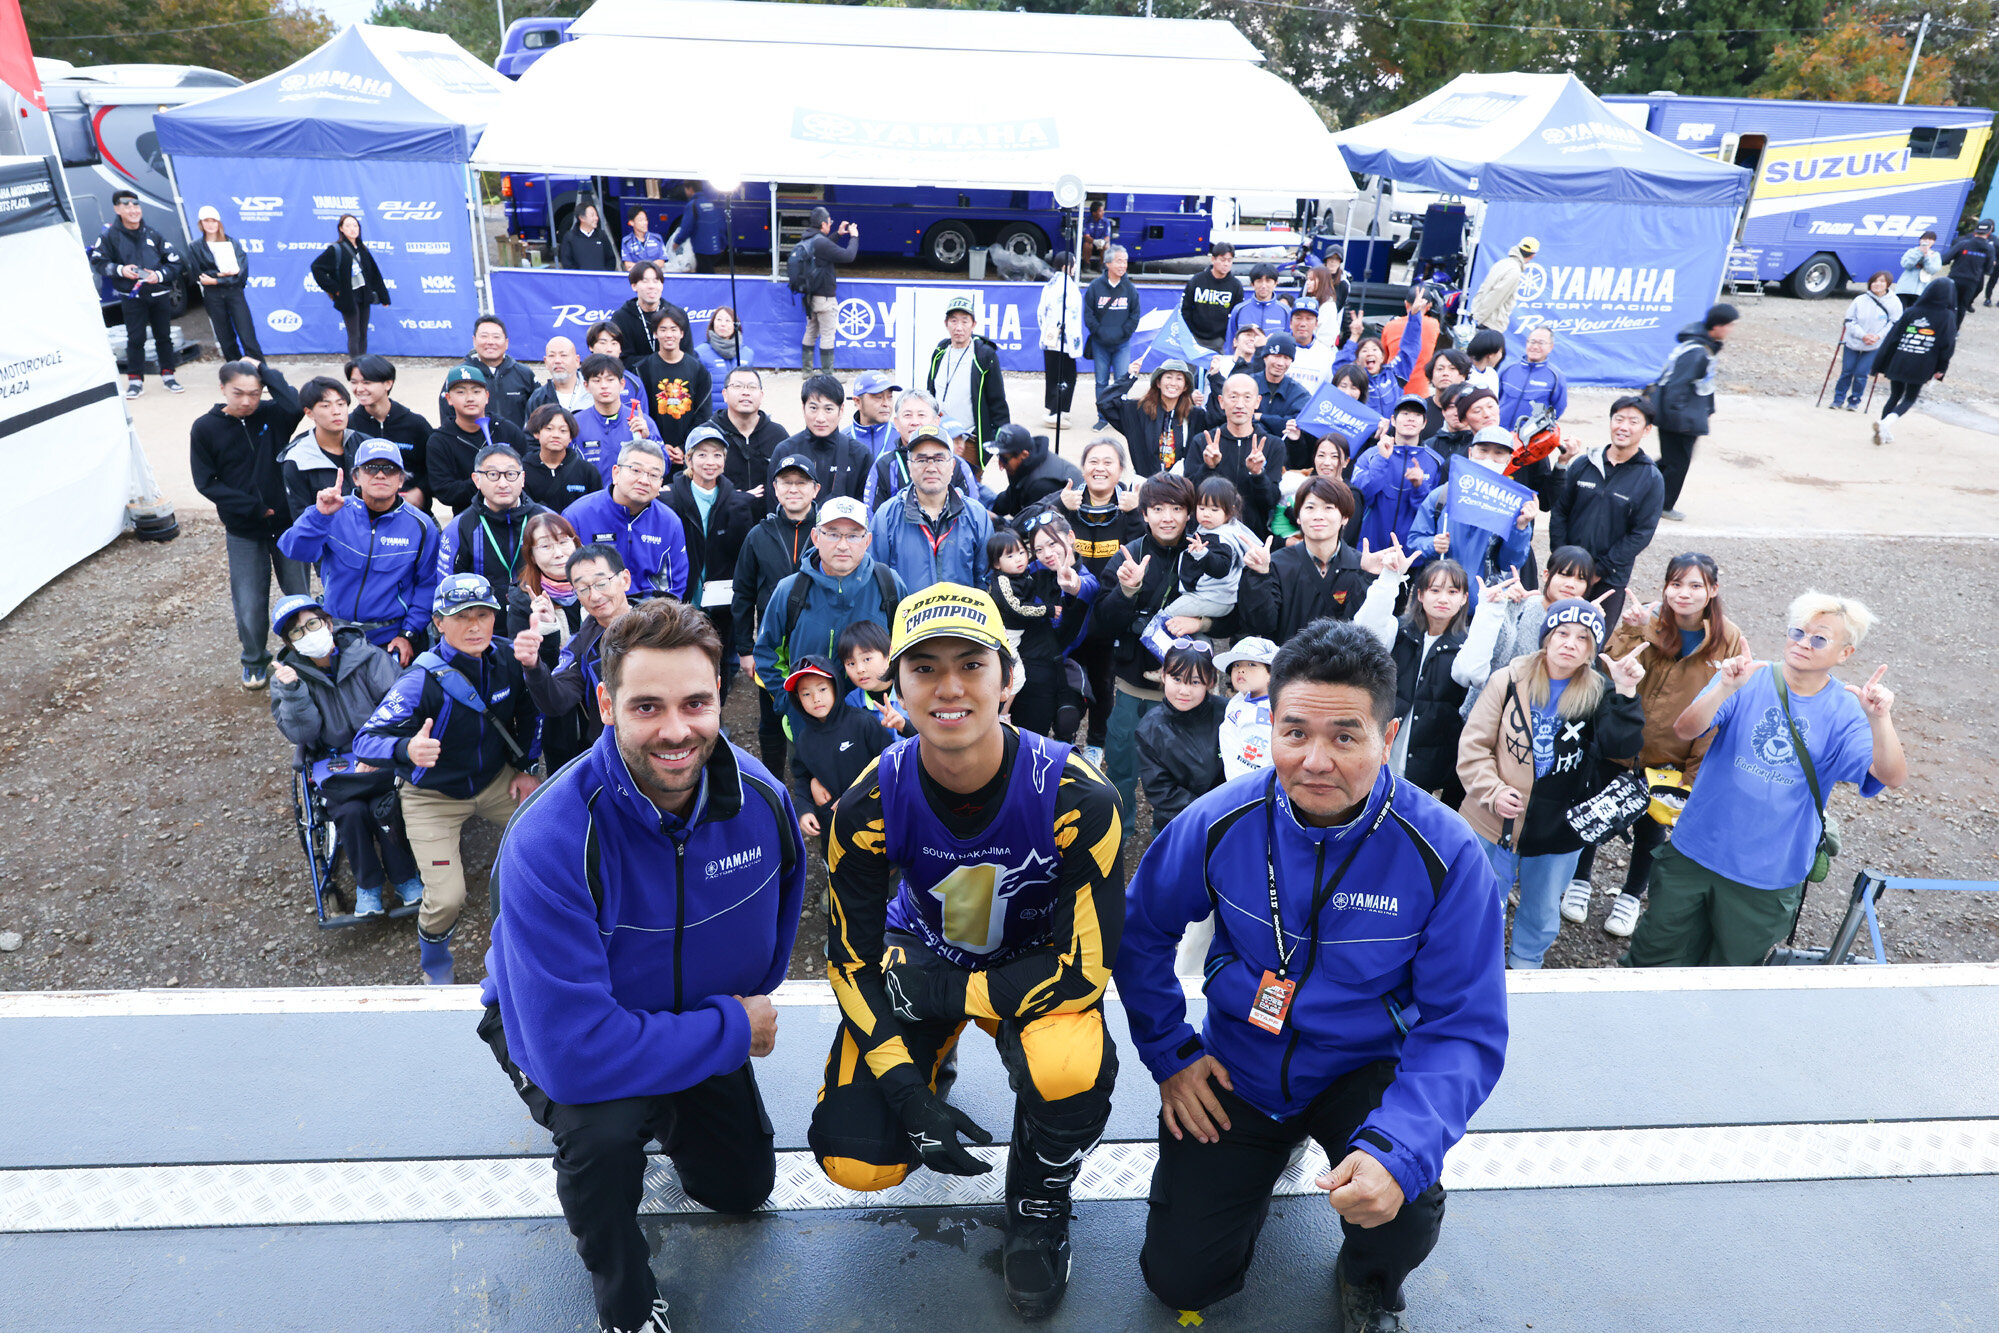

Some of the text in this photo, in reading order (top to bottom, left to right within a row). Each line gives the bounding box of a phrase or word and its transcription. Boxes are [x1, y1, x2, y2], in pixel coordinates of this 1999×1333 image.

[308, 70, 392, 98] YAMAHA
[860, 121, 1049, 144] YAMAHA
[1763, 146, 1912, 184] SUZUKI
[231, 196, 284, 211] YSP
[377, 201, 437, 210] BLU
[382, 211, 443, 221] CRU
[1854, 214, 1938, 237] SBE
[288, 242, 328, 250] DUNL
[363, 241, 394, 250] XCEL
[247, 276, 276, 288] YB
[420, 275, 456, 289] NGK
[1551, 266, 1676, 303] YAMAHA
[552, 304, 717, 328] Rev ear
[1518, 302, 1673, 312] ACTORY RACING
[418, 319, 453, 330] GEAR
[1514, 314, 1660, 335] Revs Your Heart
[836, 340, 896, 349] FACT
[0, 350, 64, 381] MOTORCYCLE
[1329, 405, 1369, 433] YAMAHA
[1475, 478, 1523, 509] YAMAHA
[911, 594, 985, 612] DUNLOP
[905, 604, 988, 635] CHAMPION
[718, 845, 762, 871] YAMAHA
[922, 846, 1012, 861] SOUYA NAKAJIMA
[704, 868, 736, 880] FACTORY
[928, 862, 1008, 955] 1
[1349, 892, 1398, 913] YAMAHA
[1368, 908, 1398, 917] RACING
[1254, 1011, 1280, 1025] STAFF
